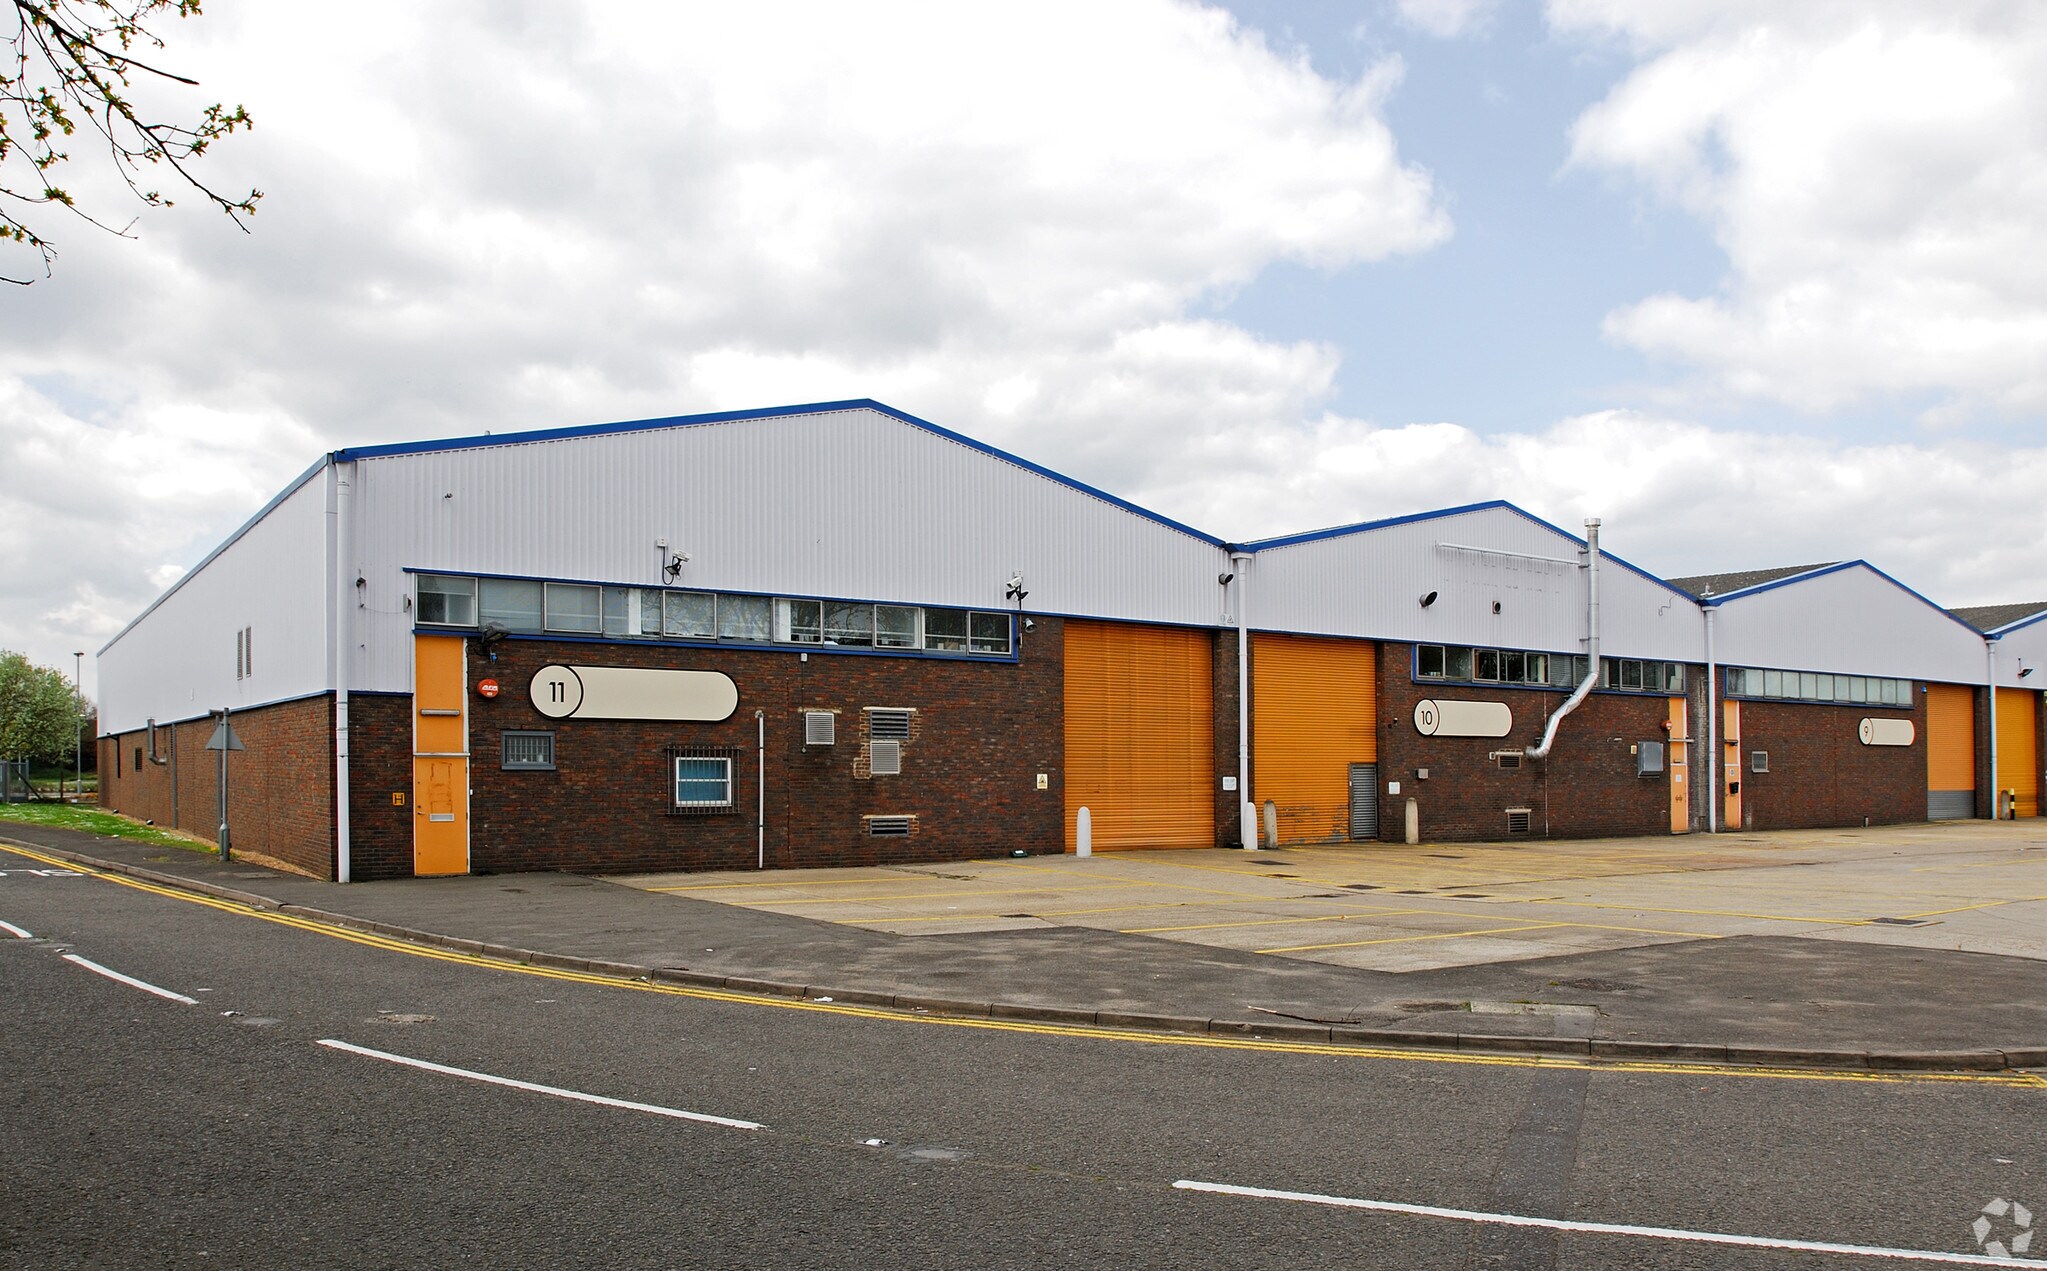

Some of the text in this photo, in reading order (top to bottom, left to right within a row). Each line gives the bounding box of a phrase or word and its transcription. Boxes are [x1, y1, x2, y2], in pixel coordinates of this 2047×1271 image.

[549, 682, 564, 702] 11
[1421, 711, 1432, 725] 10
[1864, 726, 1868, 736] 9
[395, 795, 403, 804] H
